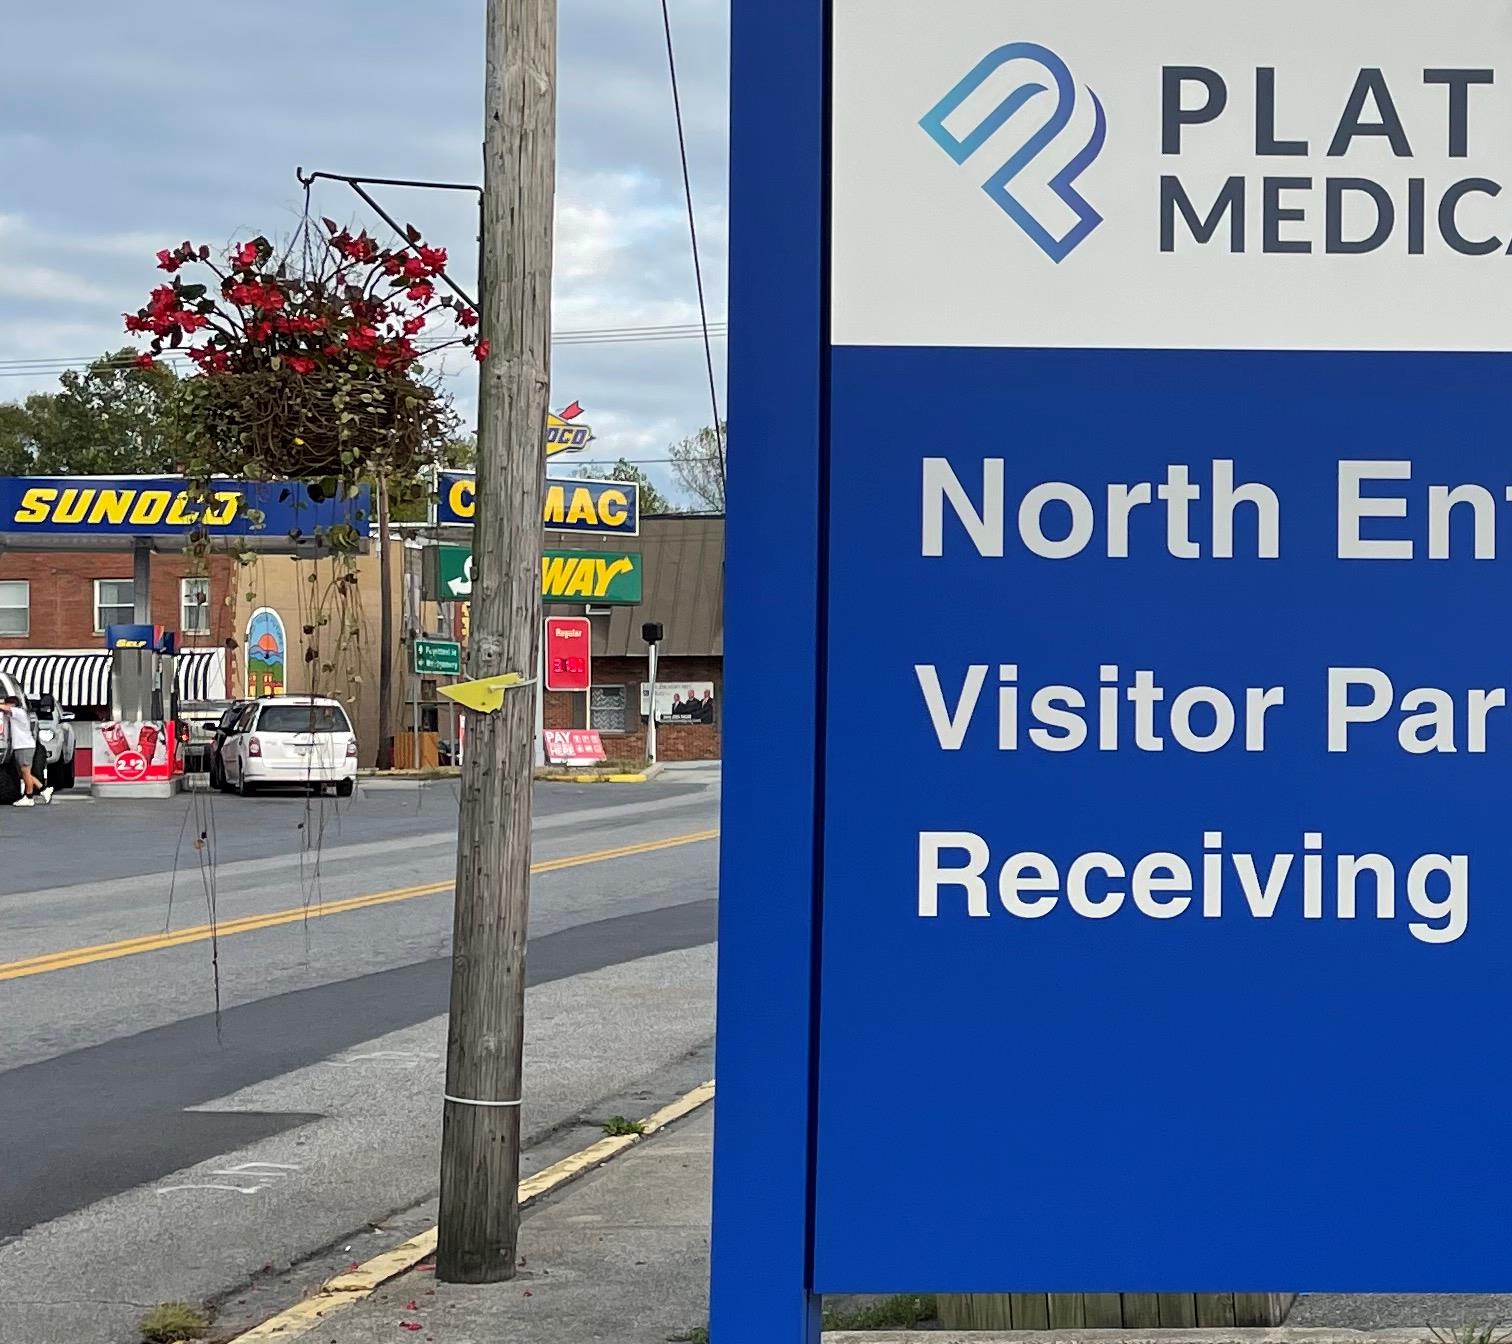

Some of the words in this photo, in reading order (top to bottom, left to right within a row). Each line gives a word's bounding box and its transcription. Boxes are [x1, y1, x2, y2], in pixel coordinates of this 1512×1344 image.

[546, 427, 587, 444] OCO
[921, 458, 1279, 558] North
[555, 627, 583, 639] Regular
[915, 665, 1283, 752] Visitor
[545, 731, 571, 744] PAY
[918, 832, 1468, 943] Receiving
